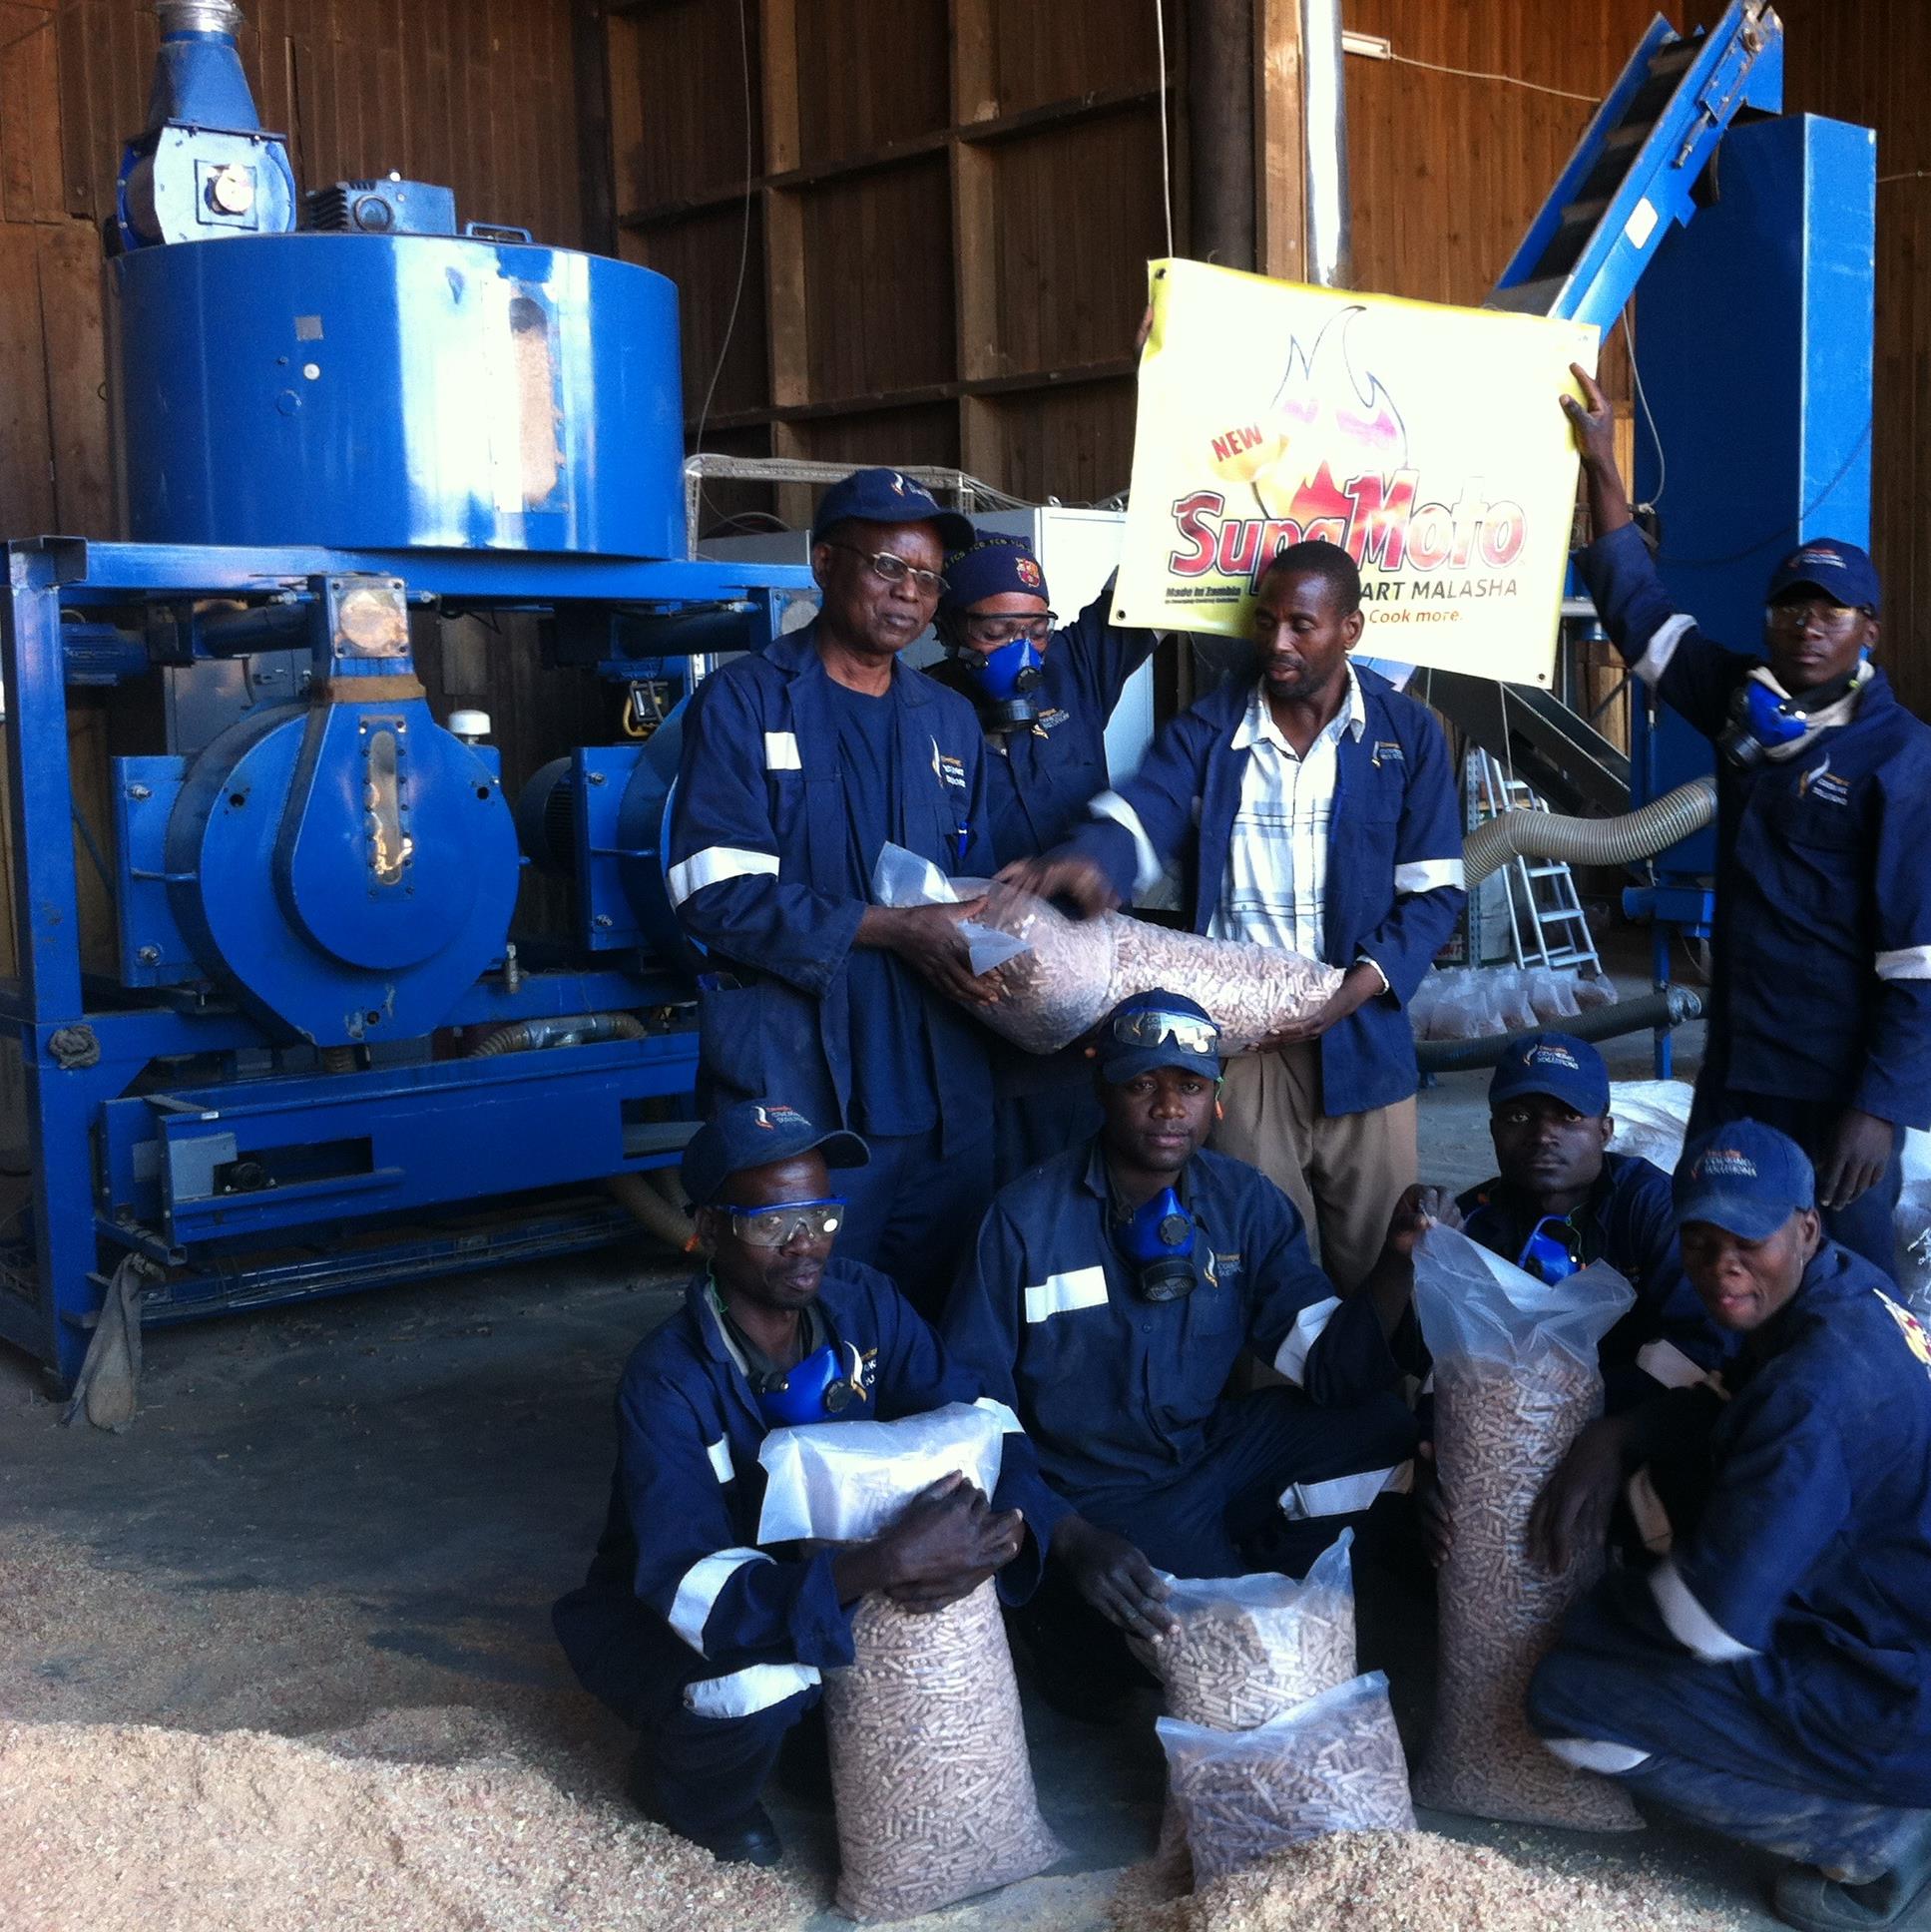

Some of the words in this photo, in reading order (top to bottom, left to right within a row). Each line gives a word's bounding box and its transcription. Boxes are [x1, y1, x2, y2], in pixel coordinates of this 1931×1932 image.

[1210, 422, 1263, 462] NEW
[1360, 581, 1406, 601] ART
[1411, 579, 1518, 600] MALASHA
[1369, 609, 1410, 624] Cook
